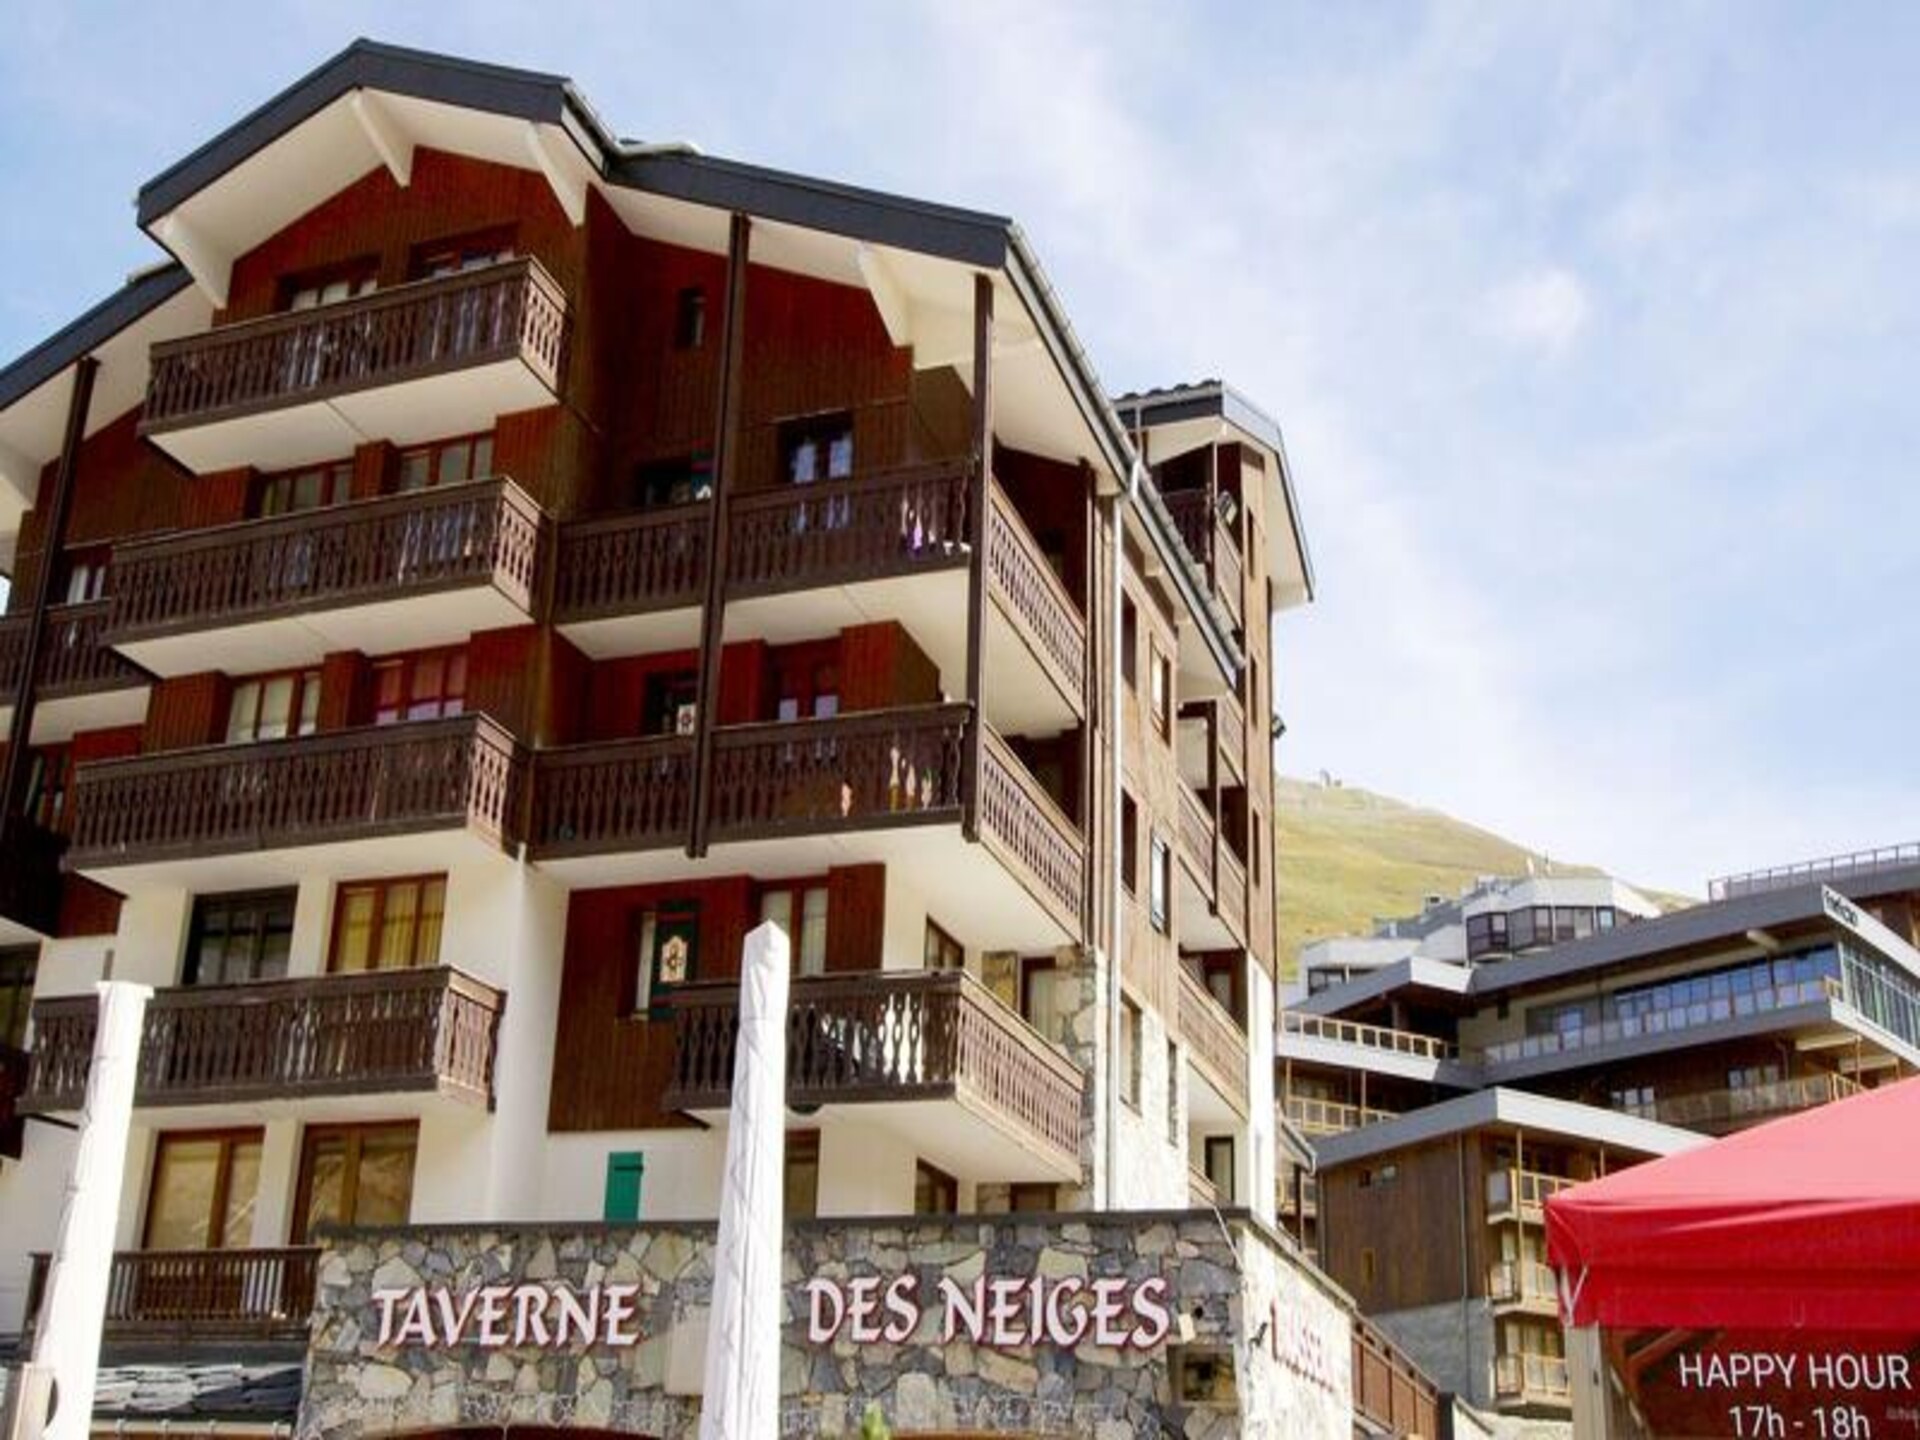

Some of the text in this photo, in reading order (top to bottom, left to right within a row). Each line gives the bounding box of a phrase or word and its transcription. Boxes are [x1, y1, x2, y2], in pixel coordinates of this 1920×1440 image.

[370, 1275, 1172, 1350] TAVERNE DES NEIGES
[1679, 1353, 1912, 1390] HAPPY HOUR
[1728, 1405, 1785, 1438] 17h
[1812, 1406, 1870, 1439] 18h
